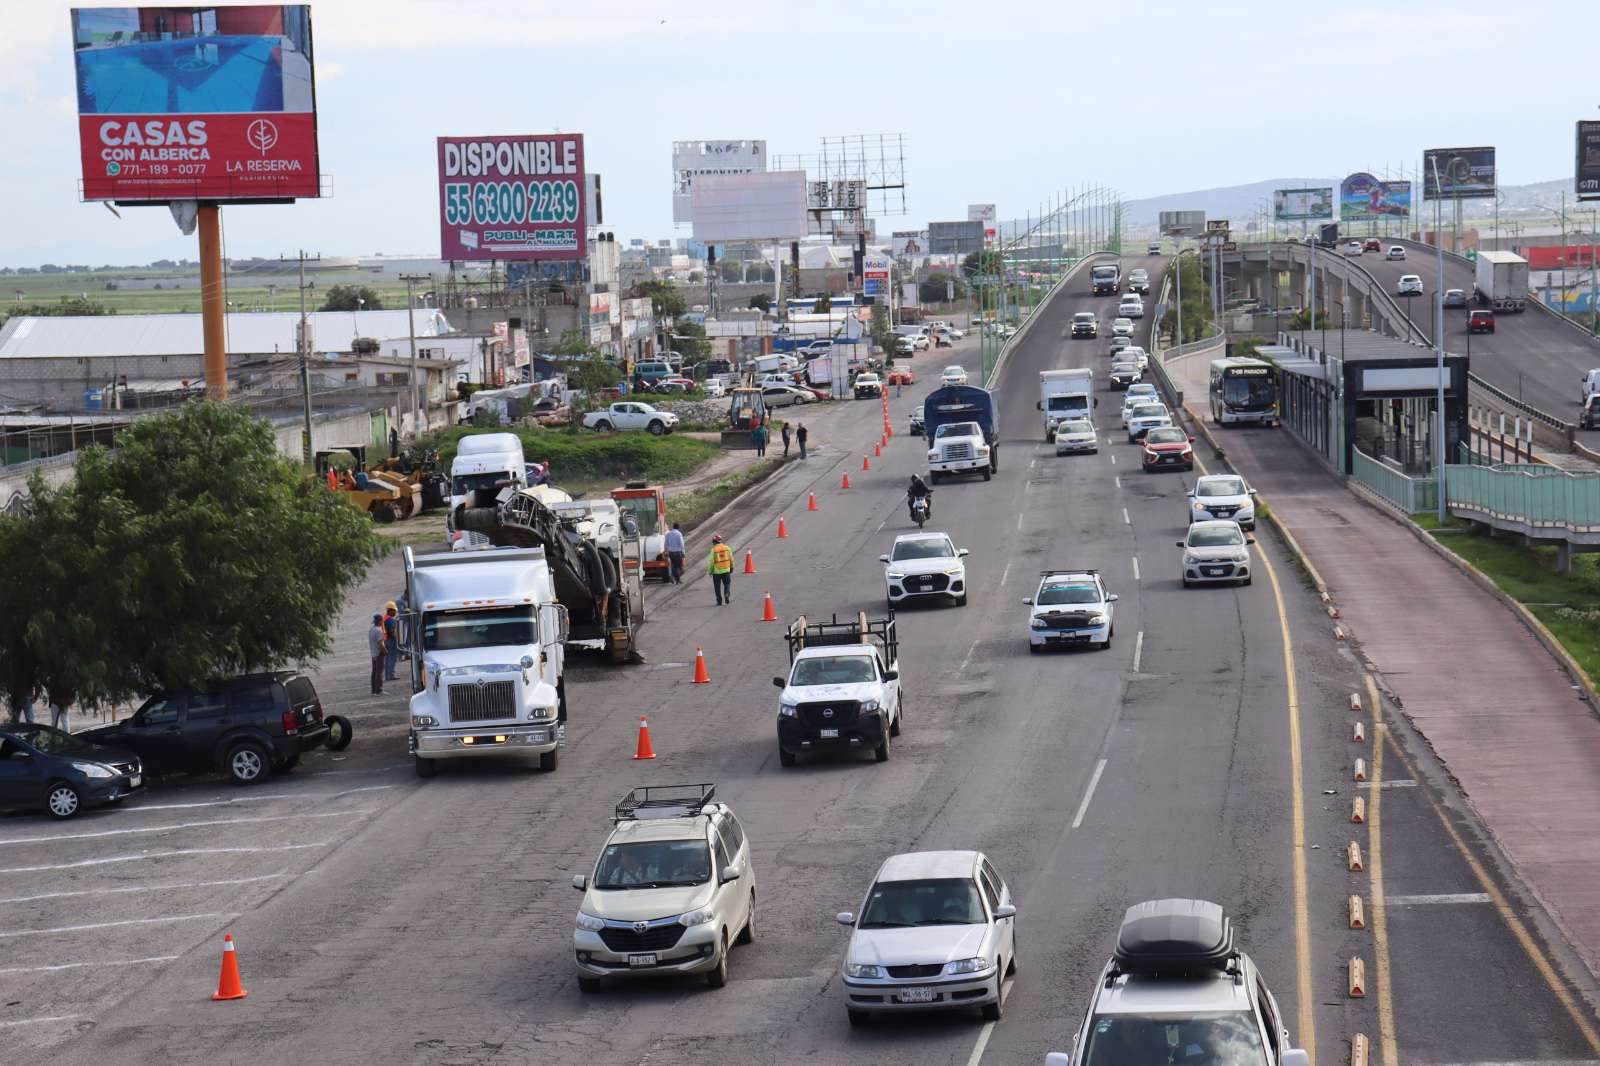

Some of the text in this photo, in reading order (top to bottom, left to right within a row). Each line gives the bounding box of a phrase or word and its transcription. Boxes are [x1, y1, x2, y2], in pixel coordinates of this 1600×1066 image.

[99, 120, 208, 146] CASAS
[101, 147, 210, 161] CON ALBERCA
[444, 140, 577, 177] DISPONIBLE
[226, 160, 302, 172] LA RESERVA
[445, 180, 579, 225] 55 6300 2239
[865, 260, 887, 269] Mobil
